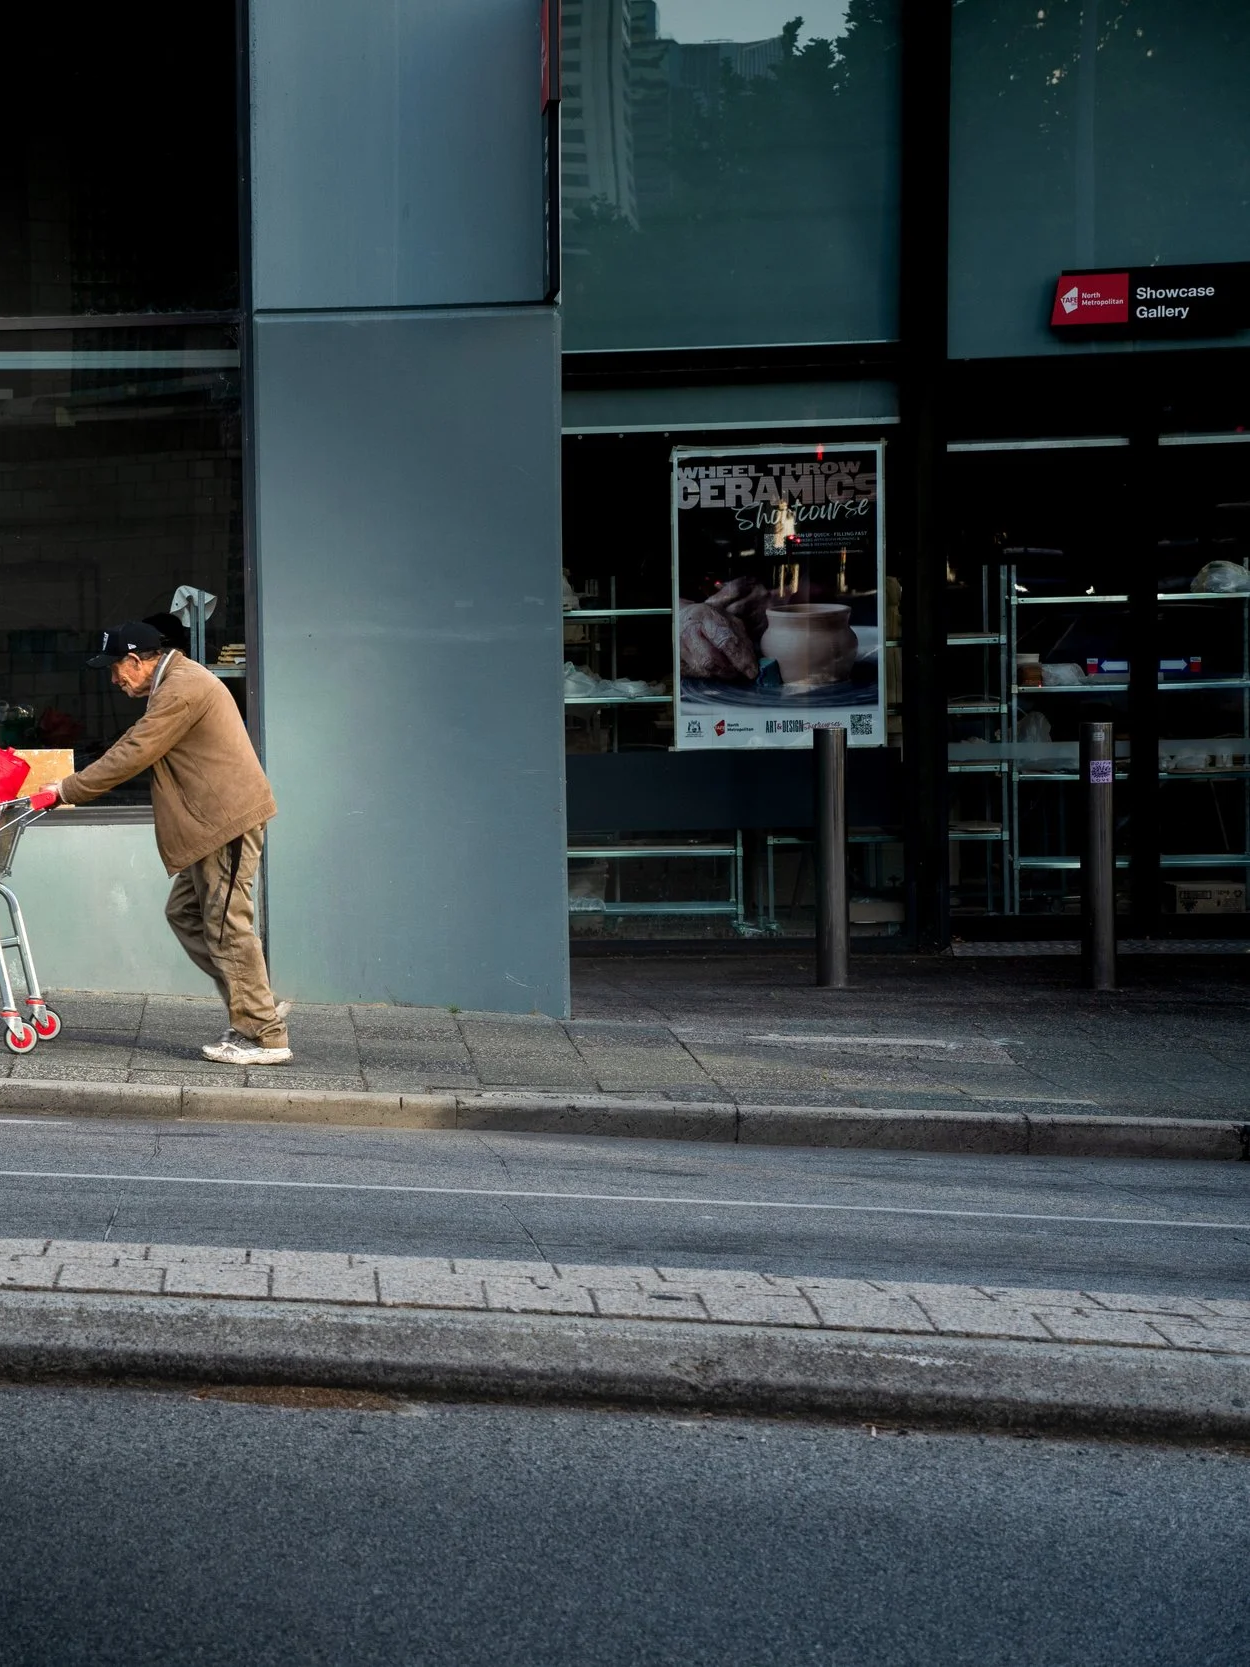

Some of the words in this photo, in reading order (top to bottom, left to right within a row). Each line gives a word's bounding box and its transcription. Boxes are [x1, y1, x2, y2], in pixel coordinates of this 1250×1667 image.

[1136, 286, 1215, 300] Showcase
[1136, 306, 1190, 319] Gallery
[678, 464, 764, 479] WHEEL
[768, 460, 862, 476] THROW
[678, 472, 876, 510] CERAMICS
[730, 498, 870, 530] Shotcourse
